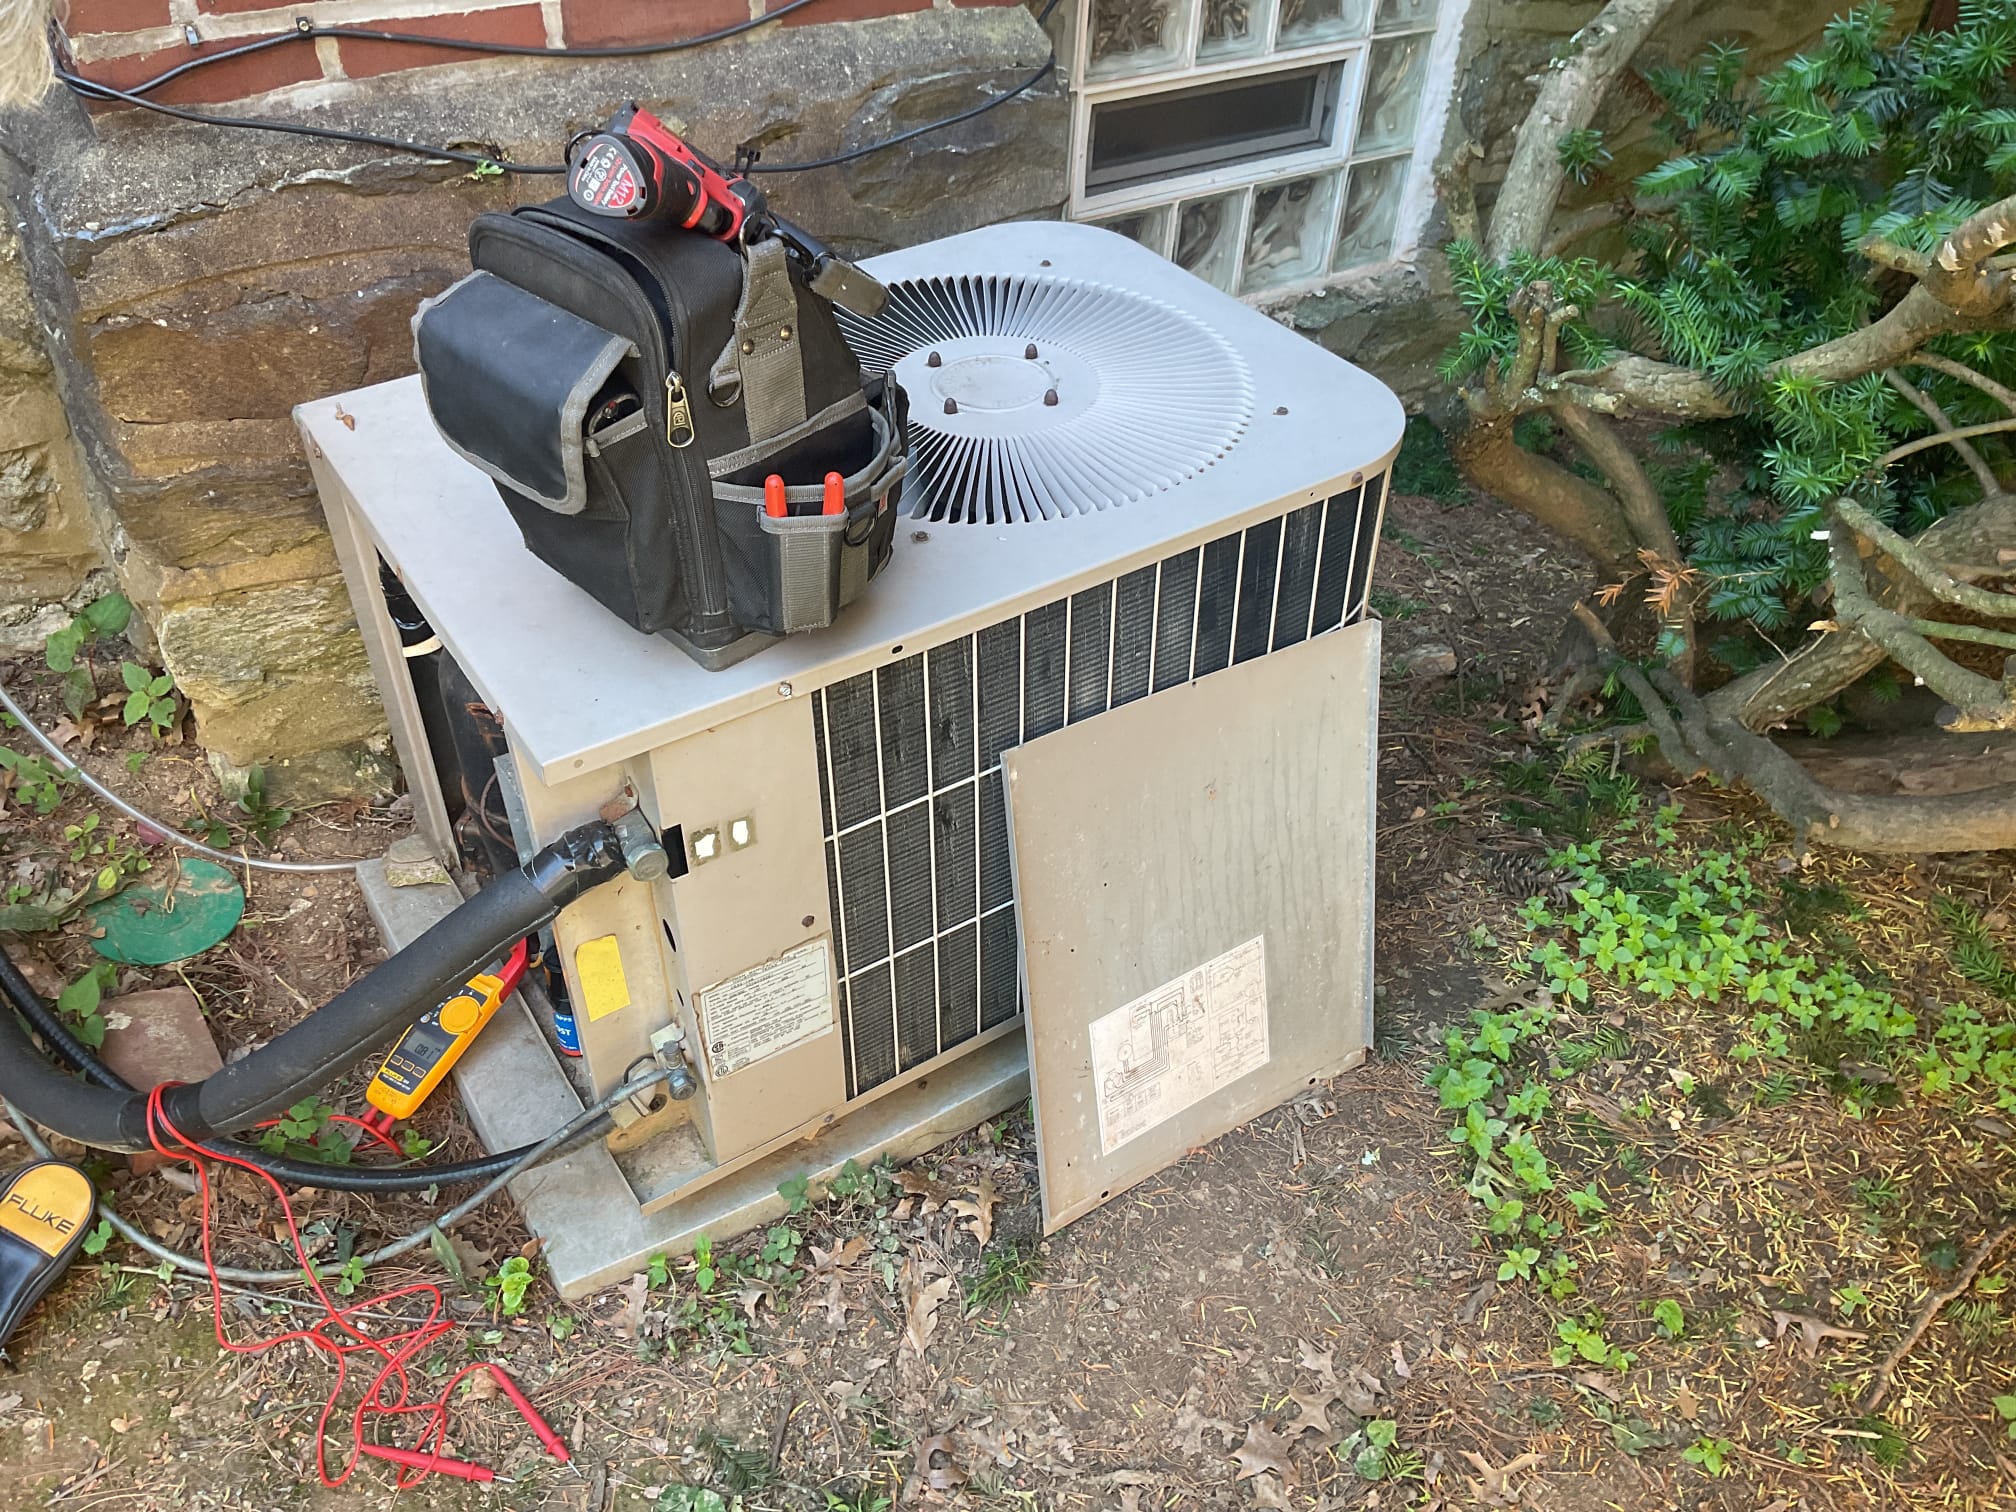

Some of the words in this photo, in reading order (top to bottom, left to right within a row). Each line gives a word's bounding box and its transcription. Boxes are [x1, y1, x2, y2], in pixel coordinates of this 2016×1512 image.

[616, 163, 628, 180] Power
[614, 179, 633, 205] M12
[7, 1193, 75, 1235] FLUKE
